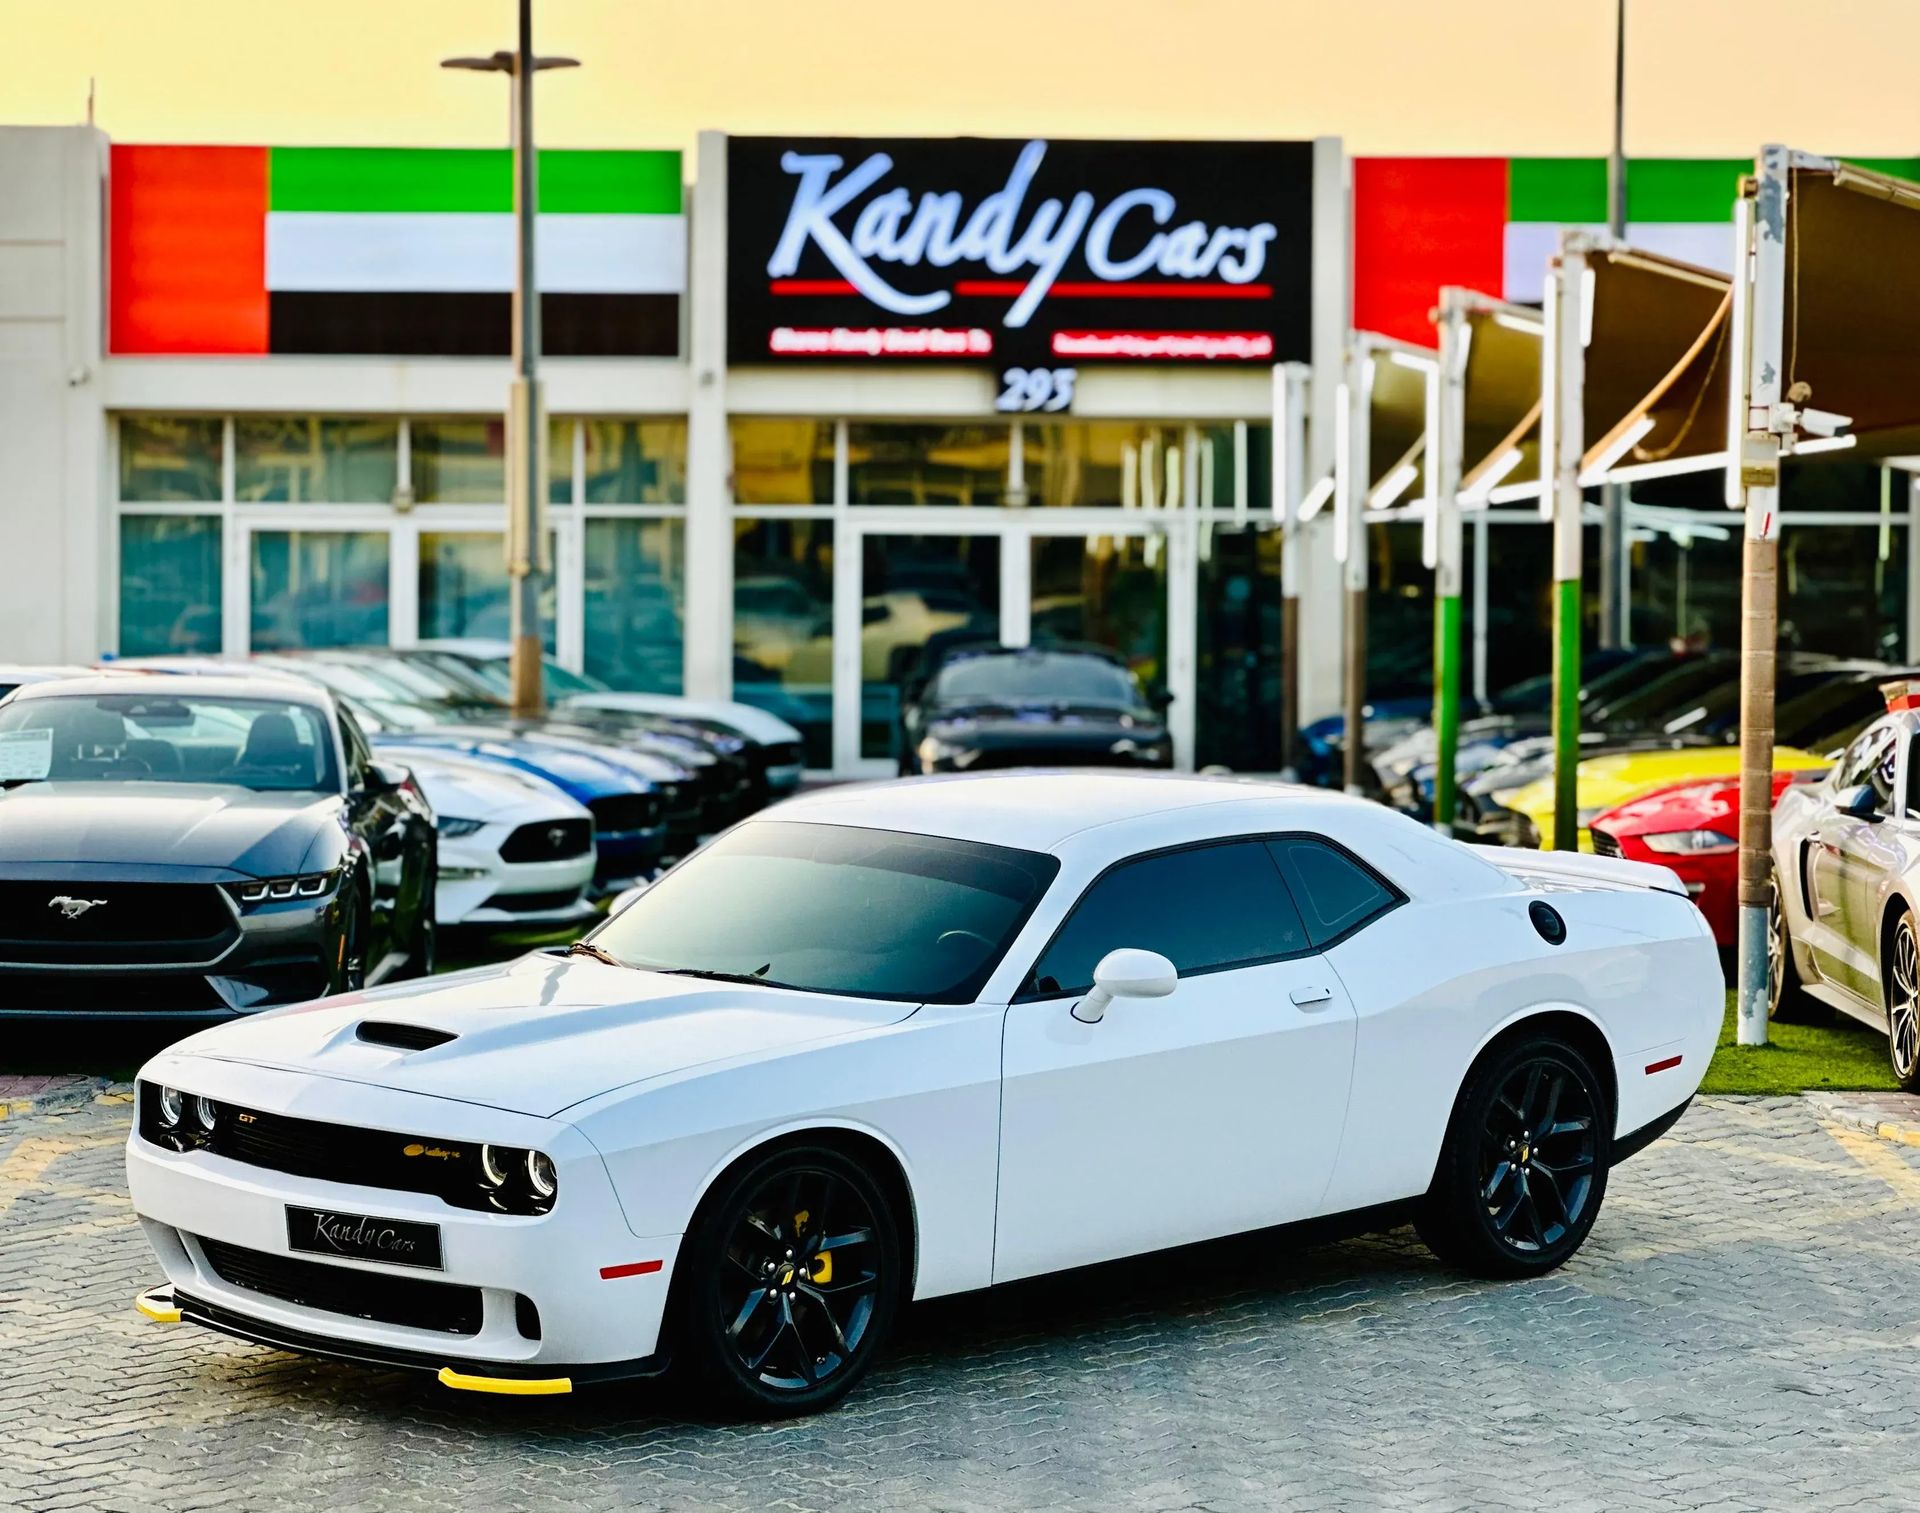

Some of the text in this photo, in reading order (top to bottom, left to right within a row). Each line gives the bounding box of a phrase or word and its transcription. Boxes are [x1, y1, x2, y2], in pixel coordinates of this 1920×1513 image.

[768, 138, 1277, 327] Kandy Cars
[996, 367, 1077, 412] 295
[239, 1113, 257, 1124] GT
[314, 1213, 416, 1252] Kandy Cars
